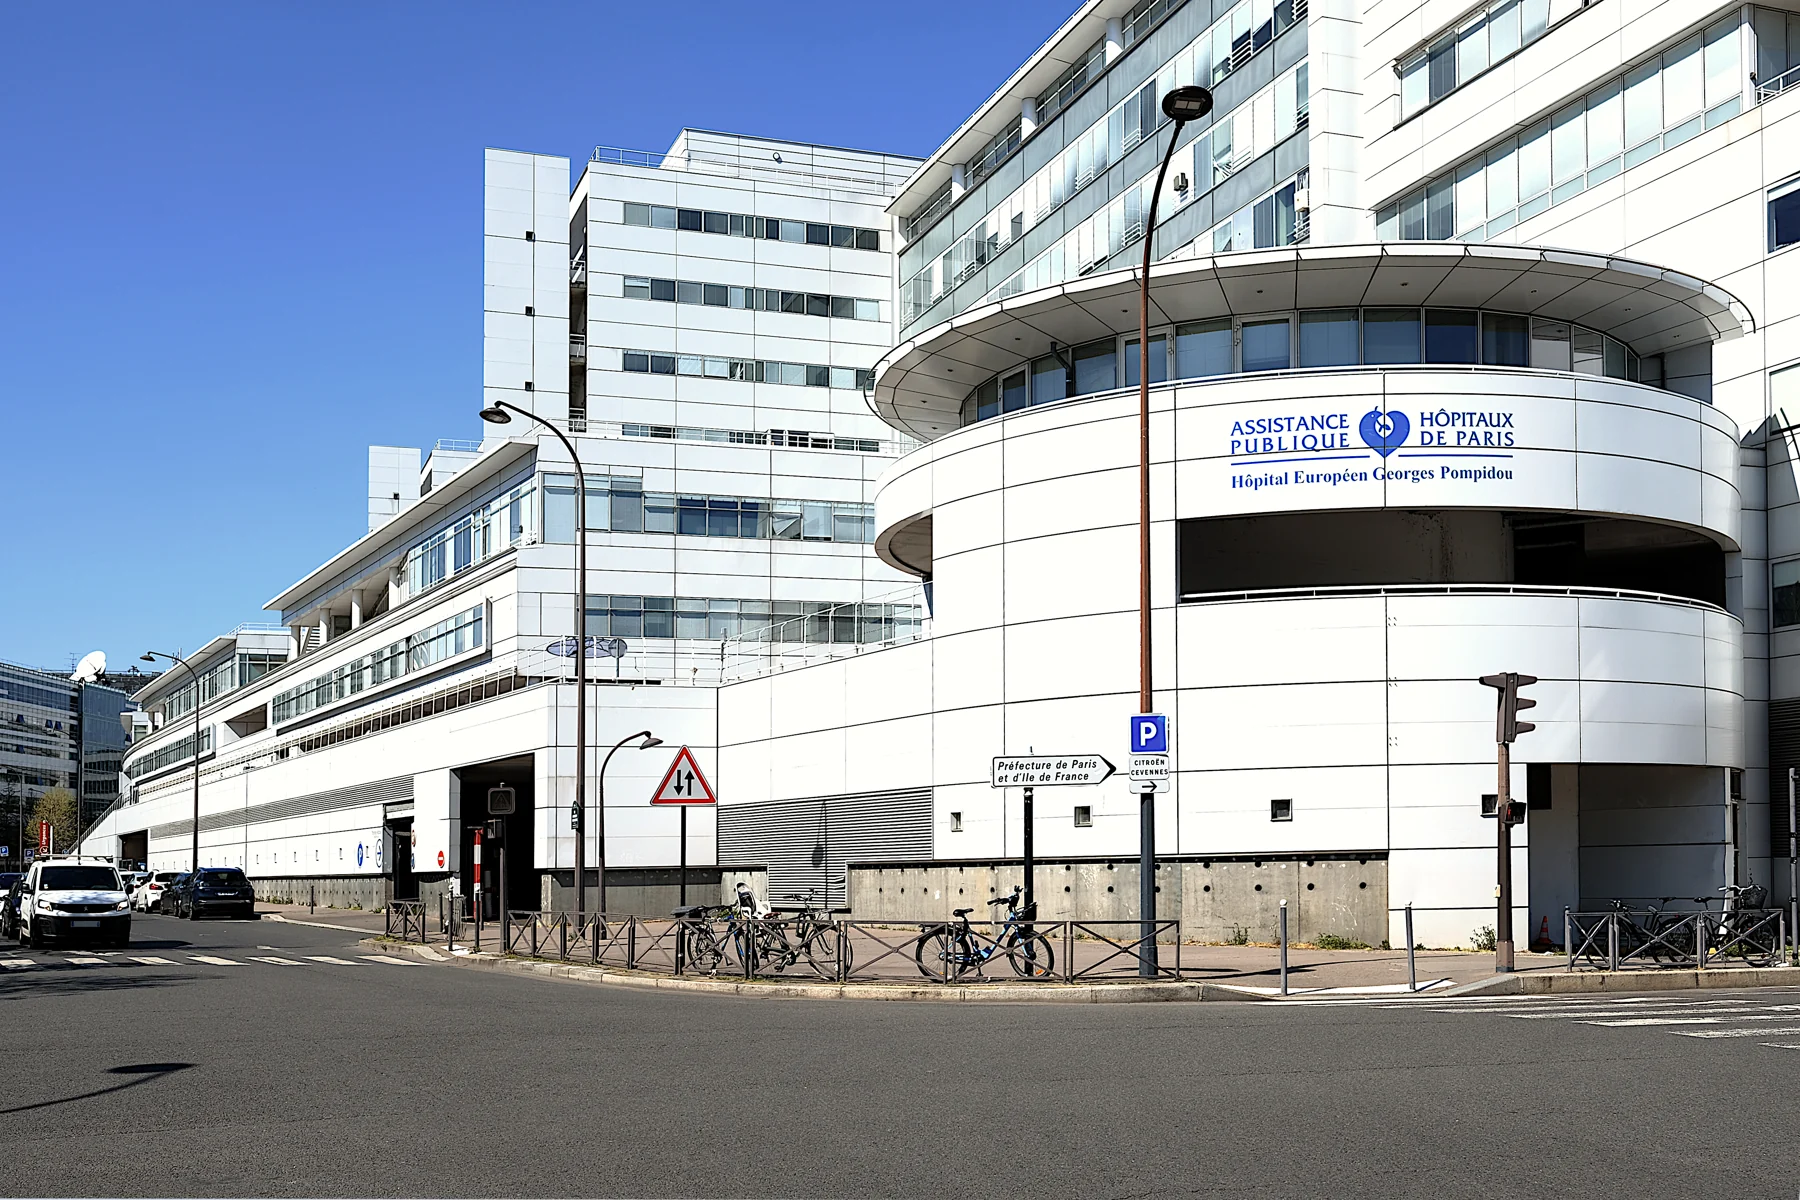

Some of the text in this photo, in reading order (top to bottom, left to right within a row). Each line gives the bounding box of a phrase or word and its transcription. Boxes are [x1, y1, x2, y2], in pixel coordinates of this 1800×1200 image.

[1230, 413, 1350, 436] ASSISTANCE
[1420, 408, 1514, 428] HÔPITAUX
[1230, 432, 1350, 454] PUBLIQUE
[1420, 430, 1514, 446] DE PARIS
[1231, 465, 1513, 490] Hôpital Européen Georges Pompidou
[1140, 722, 1157, 746] P
[998, 759, 1097, 771] Préfecture de Paris
[1134, 758, 1165, 766] CITROËN
[998, 774, 1008, 783] et
[1039, 772, 1051, 782] de
[1055, 771, 1089, 781] France
[1130, 768, 1169, 776] CEVENNES
